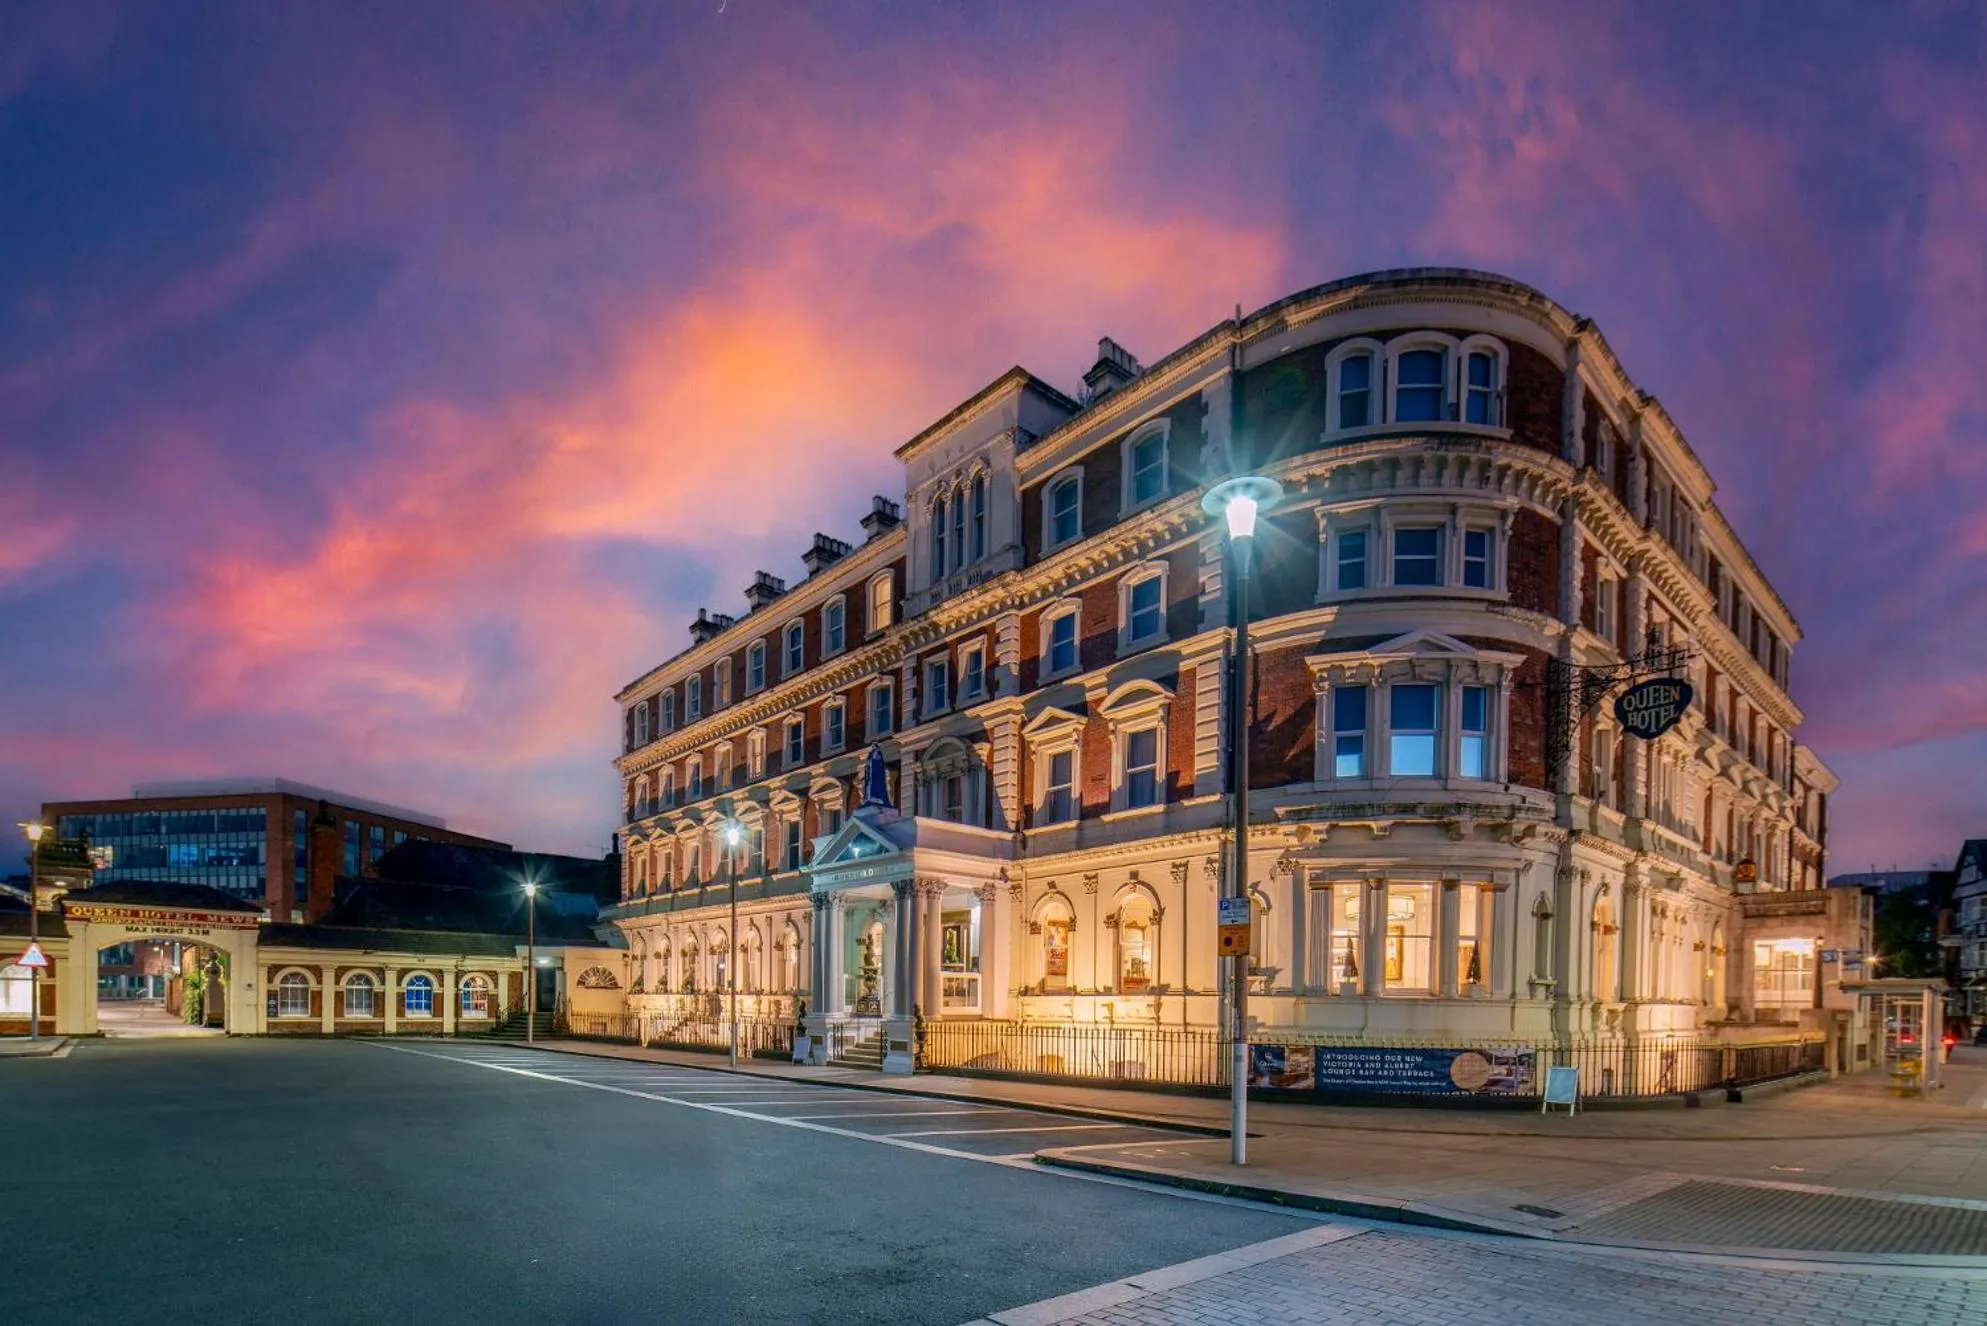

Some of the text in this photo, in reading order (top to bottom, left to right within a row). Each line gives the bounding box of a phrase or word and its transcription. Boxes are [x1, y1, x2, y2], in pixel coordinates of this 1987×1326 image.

[1623, 684, 1681, 711] QUEEN
[1627, 704, 1679, 733] HOTEL
[1222, 901, 1228, 909] P
[71, 906, 131, 917] QUEEN
[138, 909, 197, 920] HOTEL
[206, 913, 254, 924] MEWS
[125, 925, 148, 933] MAX
[151, 926, 184, 935] HEIGHT
[1404, 1055, 1424, 1063] NEW
[1365, 1061, 1381, 1069] AND
[1384, 1062, 1415, 1070] ALBERT
[1359, 1069, 1375, 1077] BAR
[1398, 1070, 1435, 1078] TERRACE
